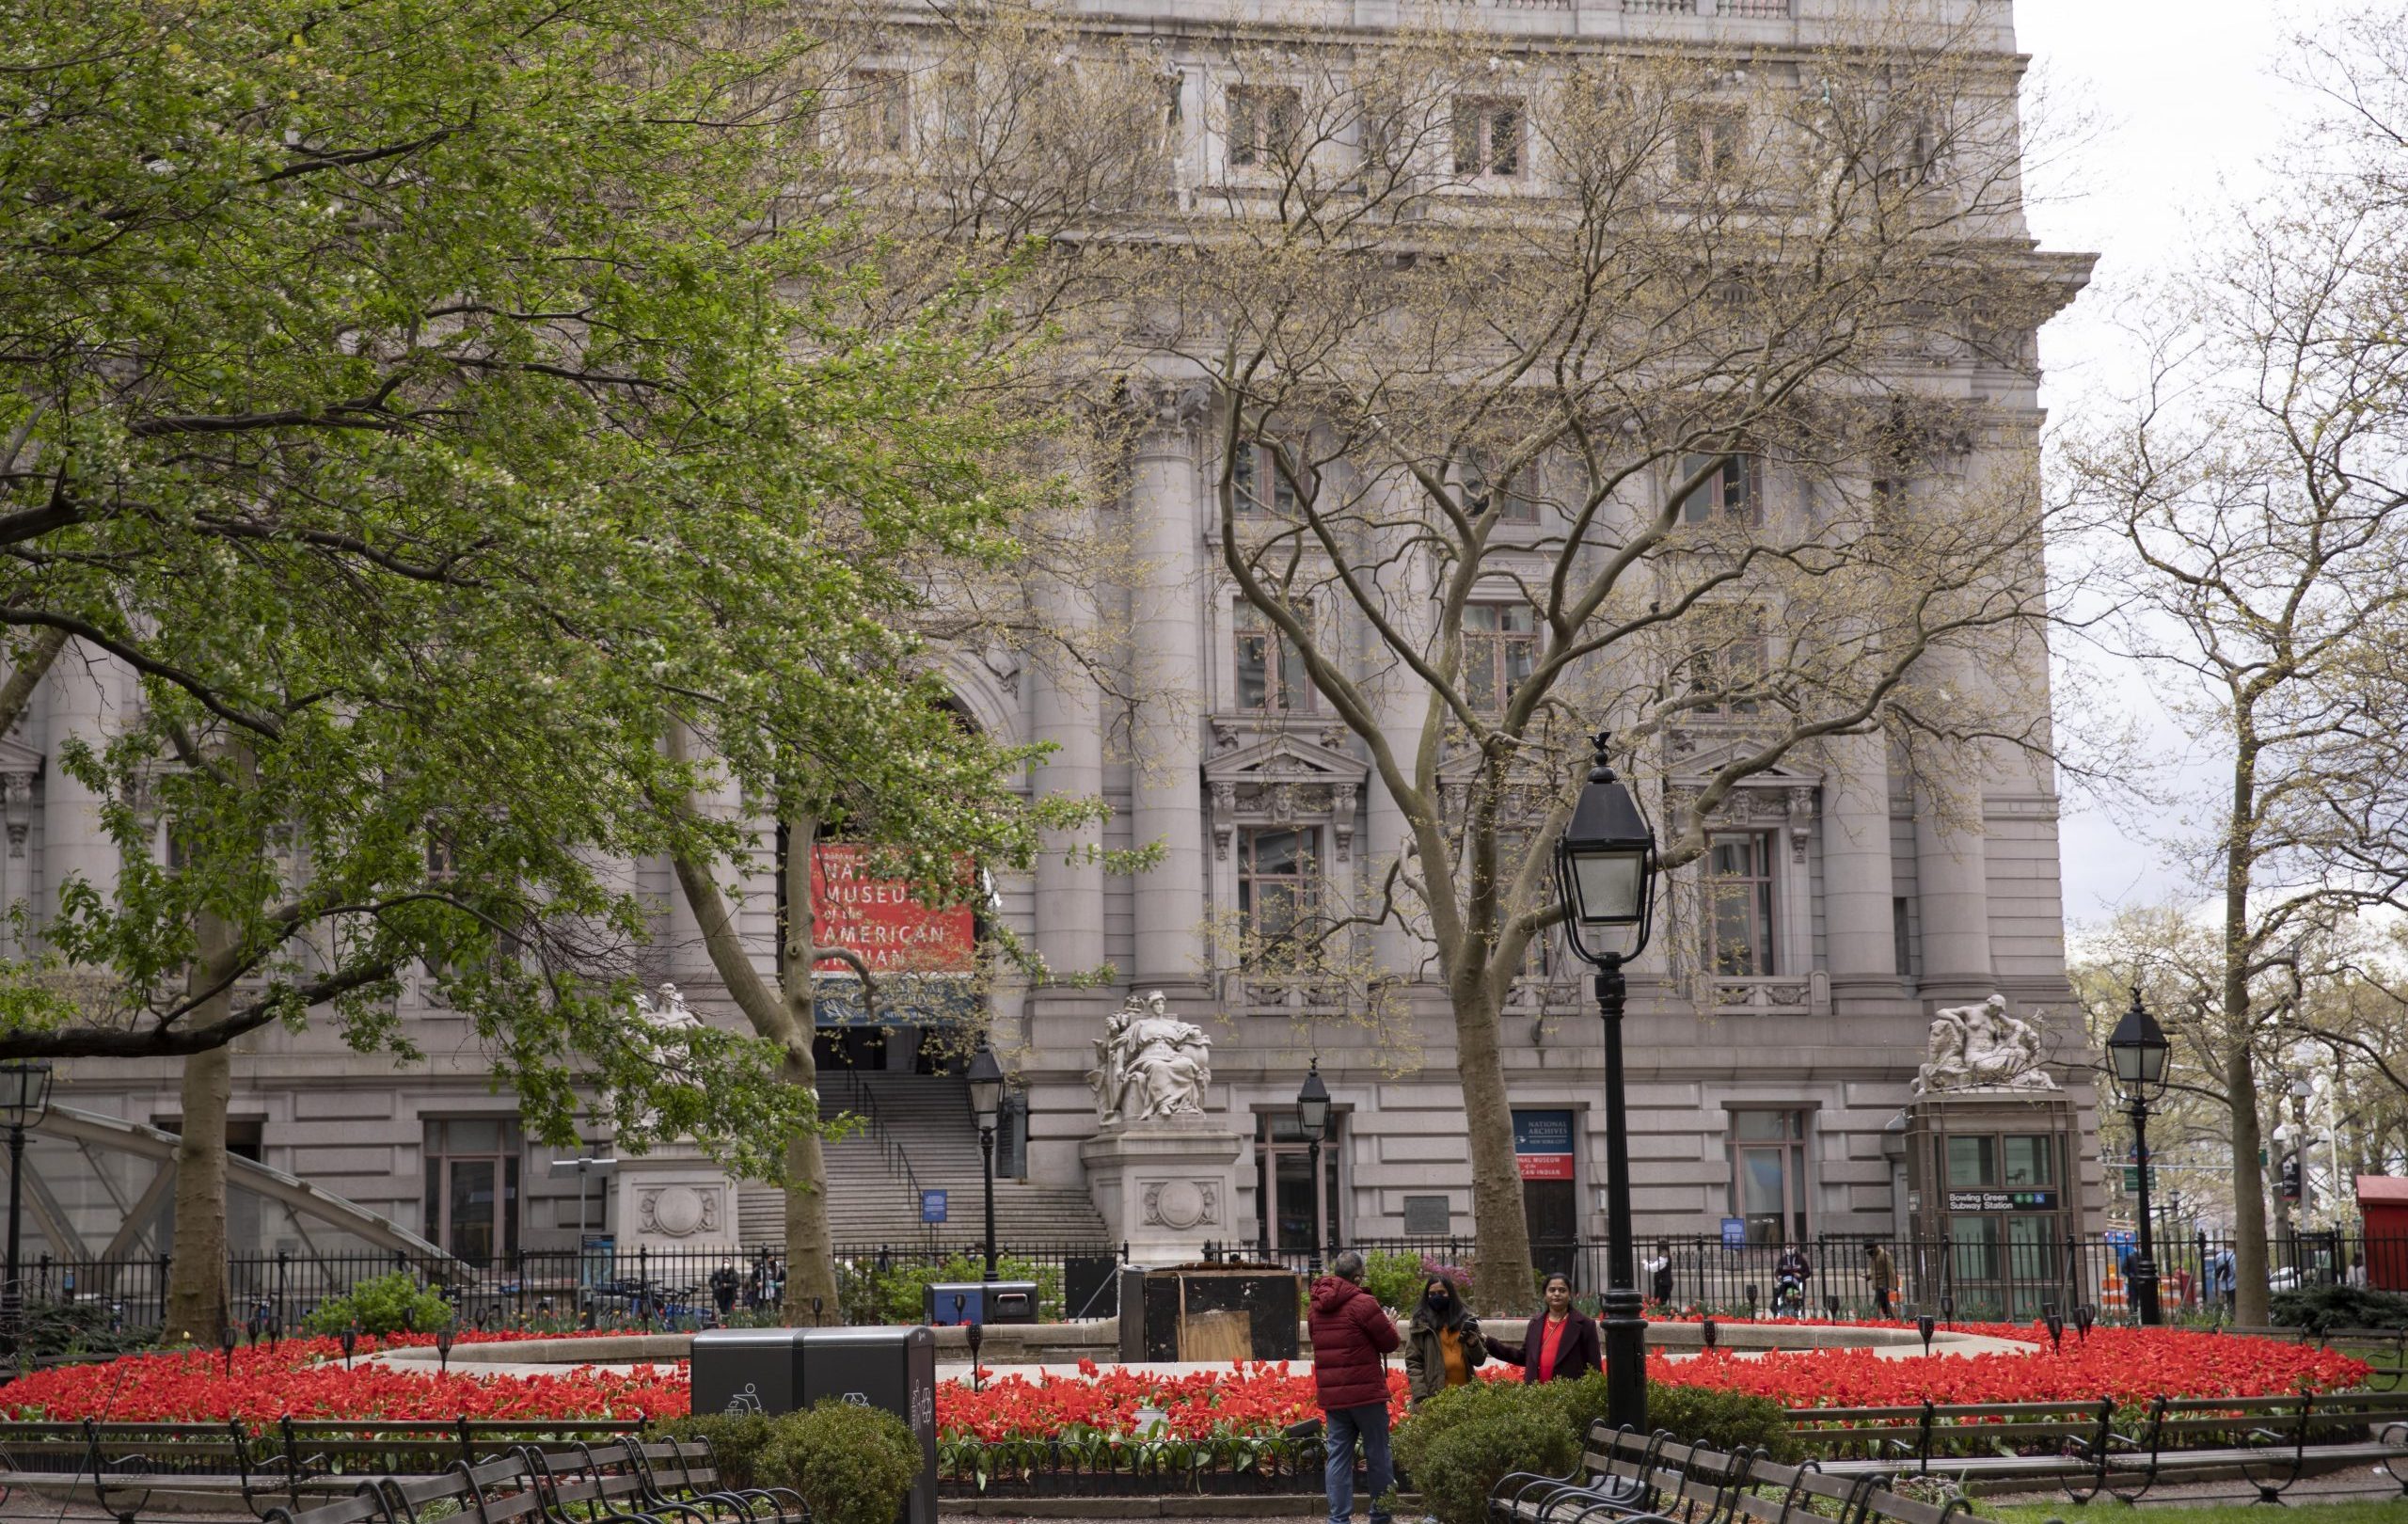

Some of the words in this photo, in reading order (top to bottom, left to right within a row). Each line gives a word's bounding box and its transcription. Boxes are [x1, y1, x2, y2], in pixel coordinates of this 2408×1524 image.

[824, 908, 835, 924] of
[842, 906, 863, 920] the
[824, 926, 943, 943] AMERICAN
[1949, 1193, 1981, 1202] Bowling
[1983, 1193, 2008, 1201] Green
[1950, 1201, 1982, 1211] Subway
[1984, 1201, 2013, 1210] Station
